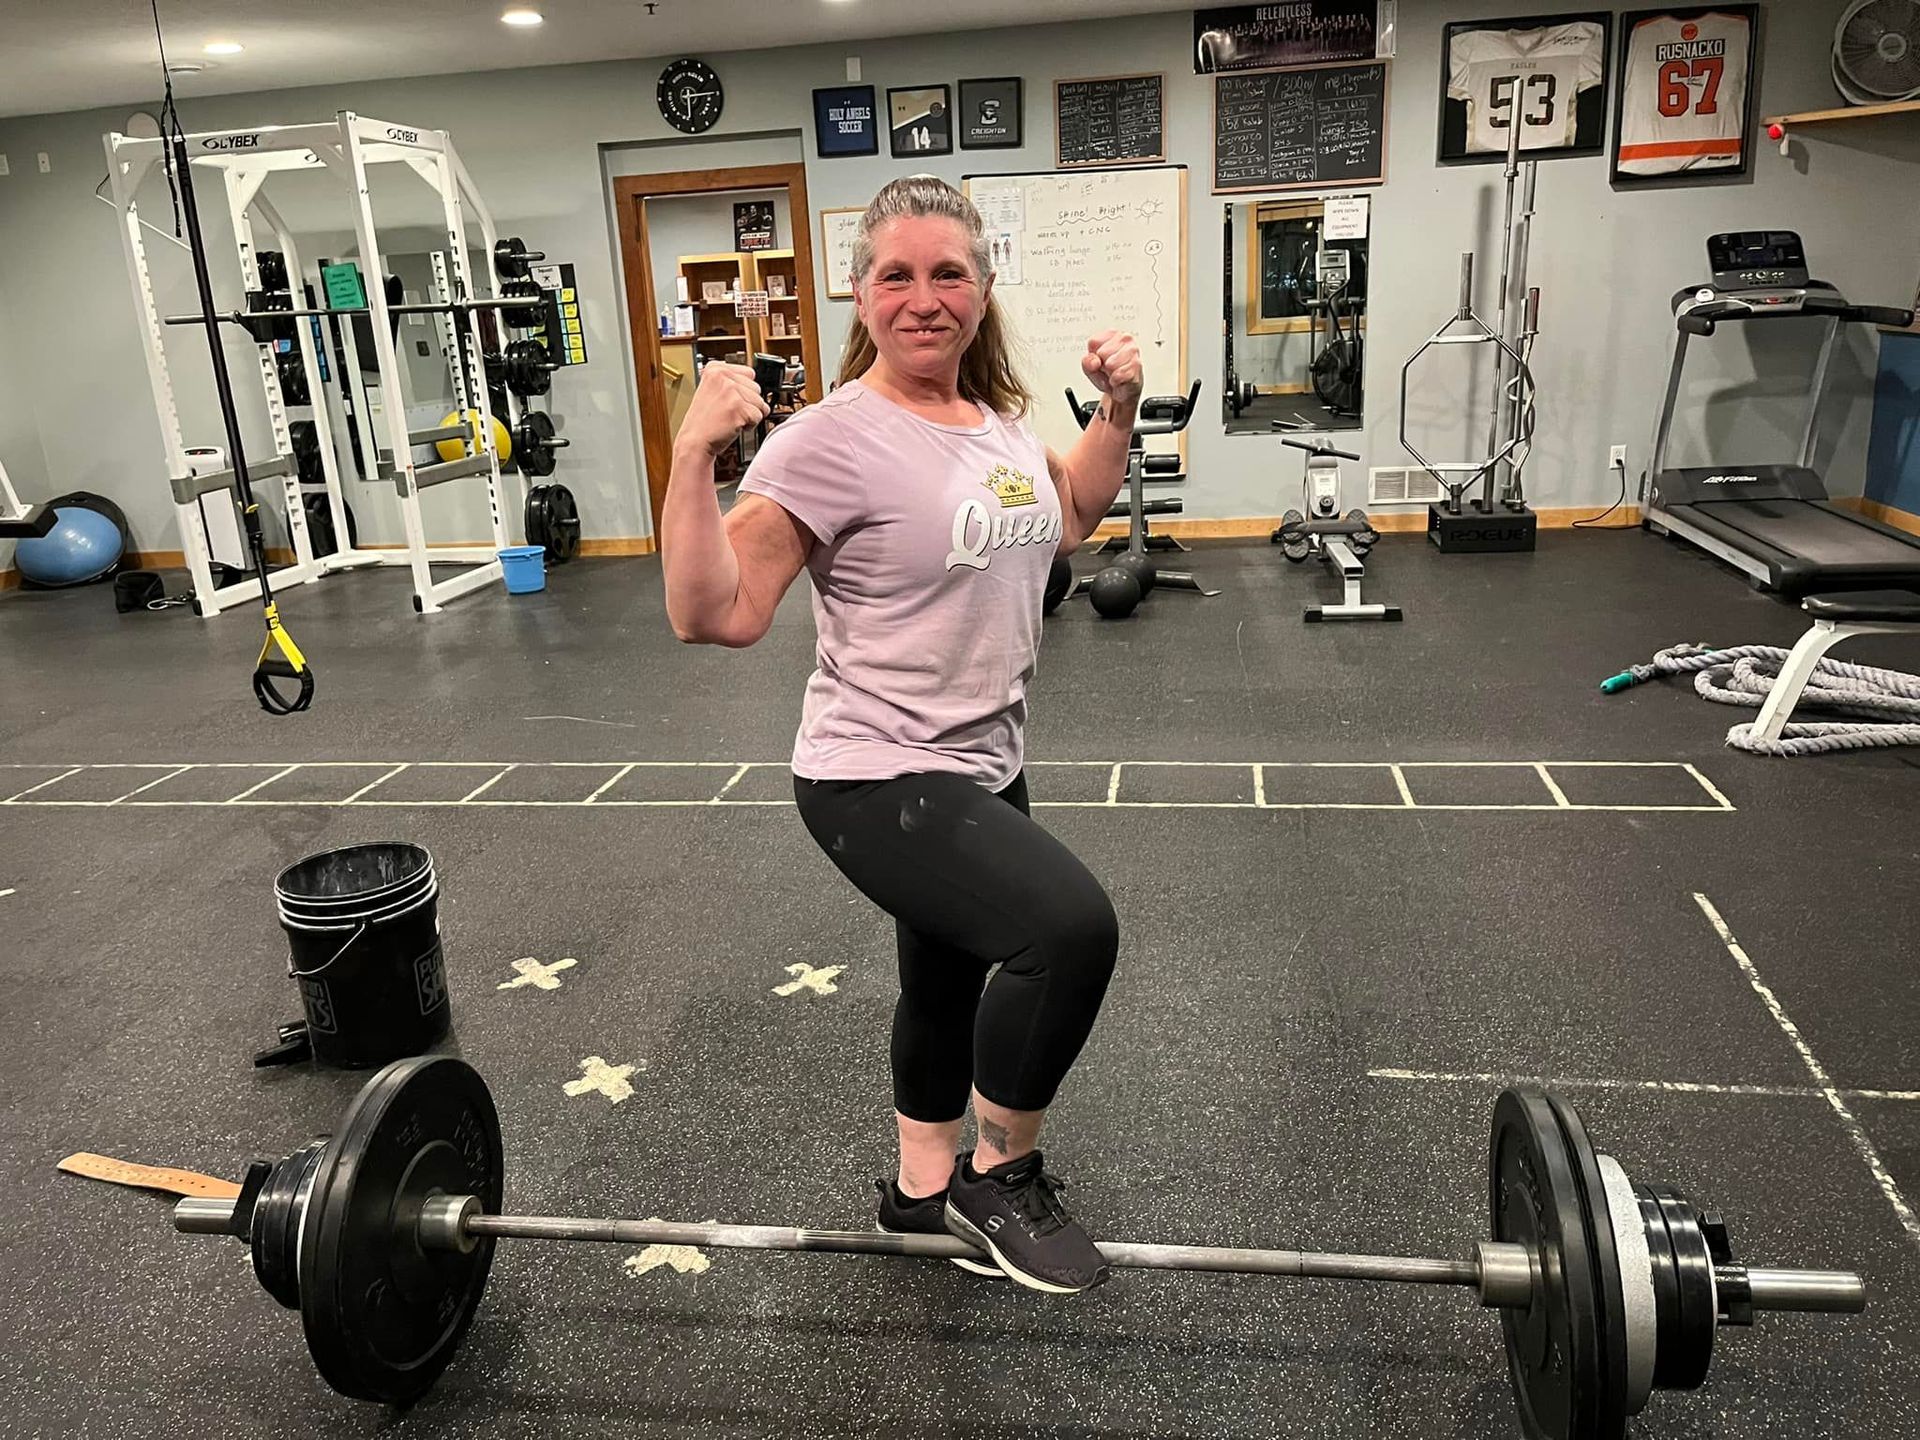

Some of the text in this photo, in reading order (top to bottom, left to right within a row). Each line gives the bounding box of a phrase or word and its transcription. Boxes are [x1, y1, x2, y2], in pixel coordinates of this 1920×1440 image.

[1256, 3, 1313, 20] RELENTLESS
[1658, 39, 1724, 61] RUSNACKO
[1657, 57, 1724, 118] 67
[1488, 73, 1556, 128] 53
[828, 107, 871, 121] HOLY ANGELS
[838, 121, 863, 133] SOCCER
[970, 127, 1007, 135] CREIGHTON
[219, 133, 260, 149] CYBEX
[396, 130, 418, 144] CYBEX
[911, 126, 931, 150] 14
[945, 498, 1061, 573] Queen
[1450, 529, 1526, 542] ROGUE
